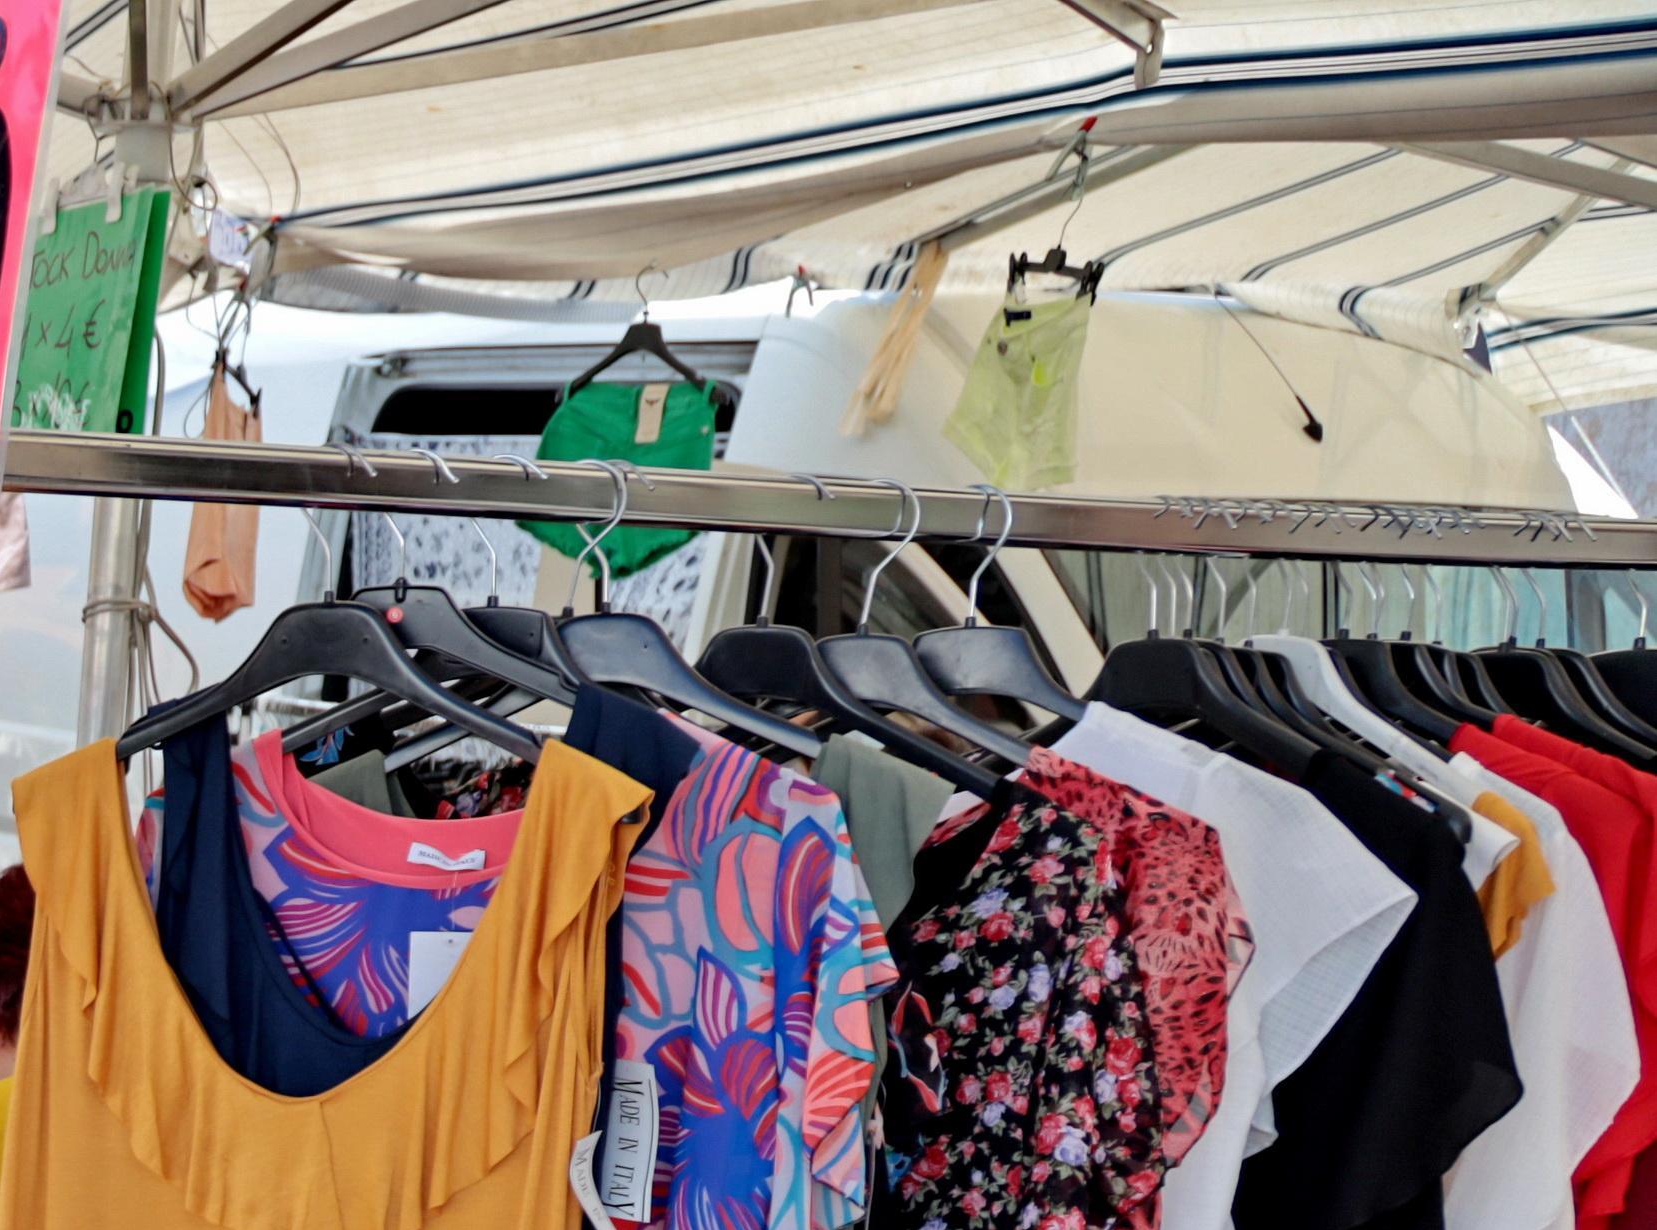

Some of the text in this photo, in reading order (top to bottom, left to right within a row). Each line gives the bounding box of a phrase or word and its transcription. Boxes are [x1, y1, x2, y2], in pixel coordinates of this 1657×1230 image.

[29, 243, 75, 290] TOCK
[574, 1144, 591, 1194] MADE
[603, 1079, 644, 1218] MADE IN ITALY
